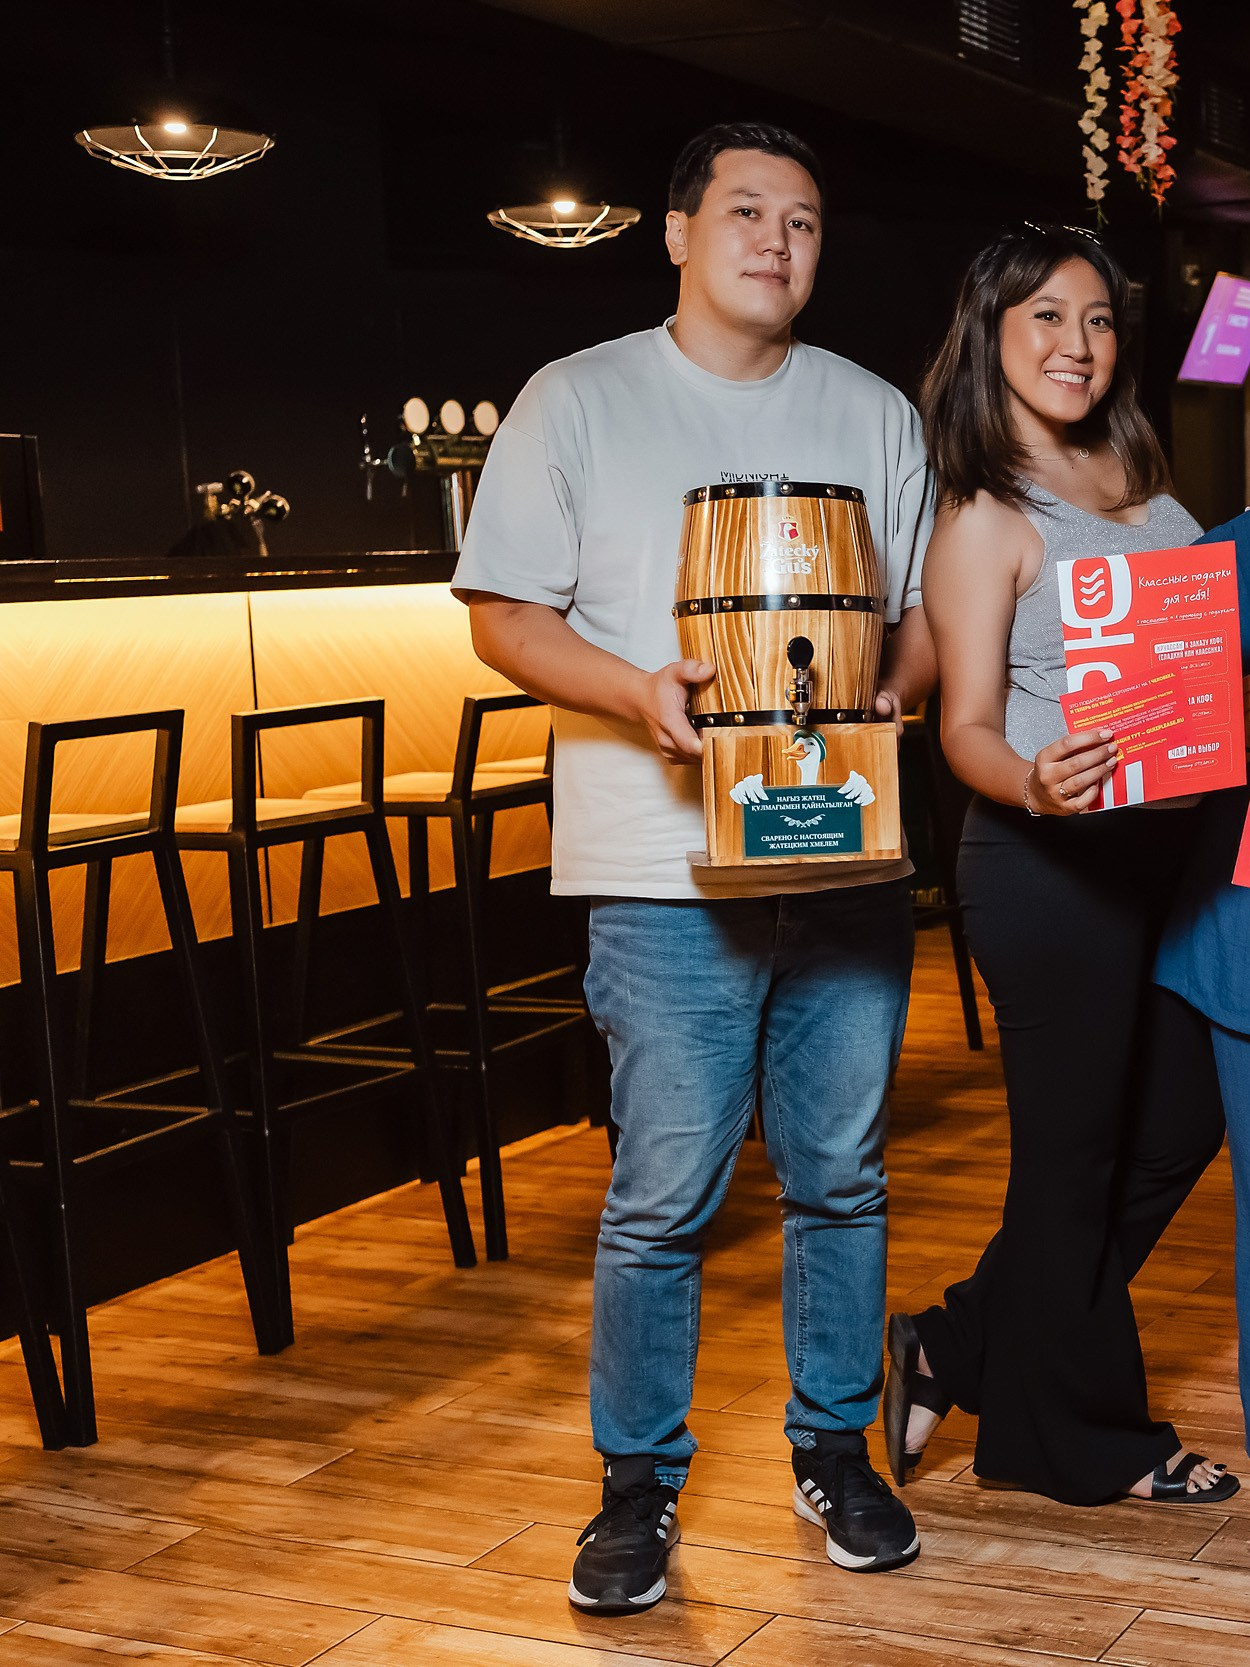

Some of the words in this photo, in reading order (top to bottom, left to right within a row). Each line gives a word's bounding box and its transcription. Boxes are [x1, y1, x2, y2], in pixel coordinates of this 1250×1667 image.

[1138, 575, 1189, 589] Классные
[1191, 569, 1232, 586] подарки
[1161, 594, 1180, 611] для
[1184, 587, 1210, 603] тебя!
[1196, 693, 1213, 704] КОФЕ
[1188, 746, 1197, 755] НА
[1198, 742, 1220, 754] ВЫБОР
[801, 794, 826, 802] ЖАТЕЦ
[769, 842, 809, 850] ЖАТЕЦКИМ
[809, 840, 839, 848] ХМЕЛЕМ
